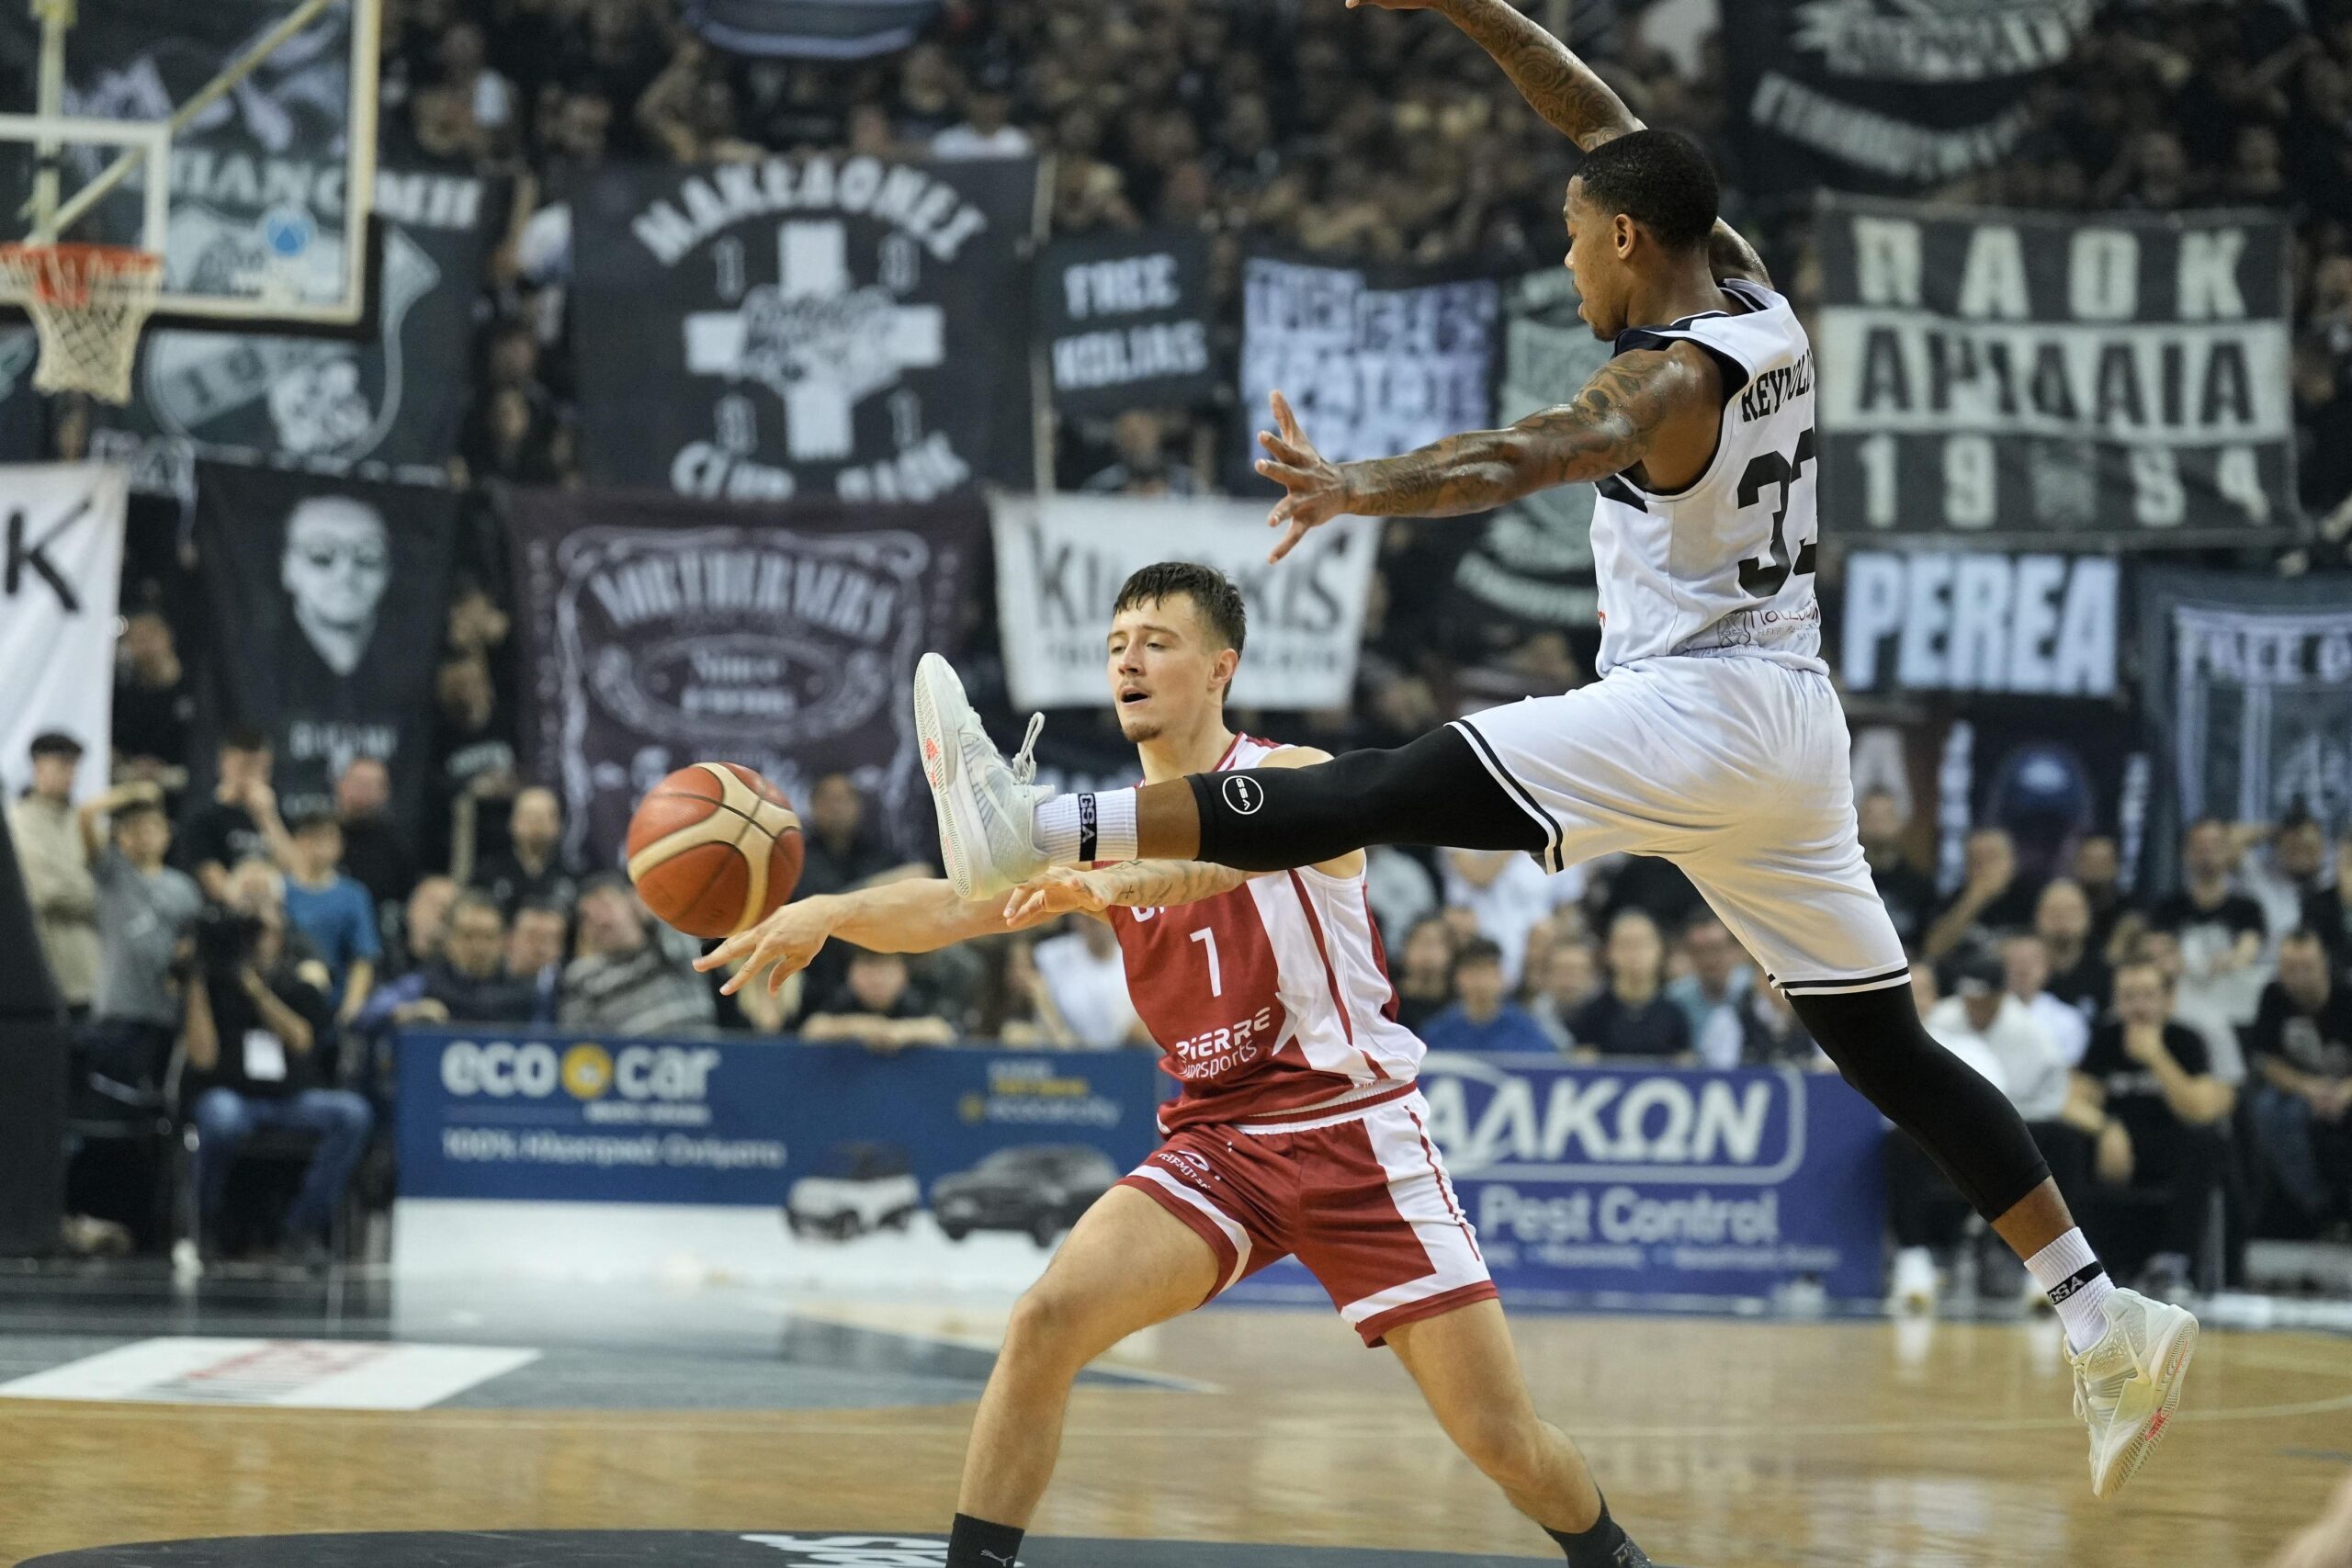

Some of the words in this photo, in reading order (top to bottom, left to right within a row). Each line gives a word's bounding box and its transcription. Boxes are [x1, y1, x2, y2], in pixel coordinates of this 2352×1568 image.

[1840, 552, 2120, 698] PEREA
[1079, 794, 1097, 844] GSA
[1235, 778, 1250, 811] GSA
[1477, 1183, 1591, 1242] Pest
[1598, 1185, 1781, 1245] Control
